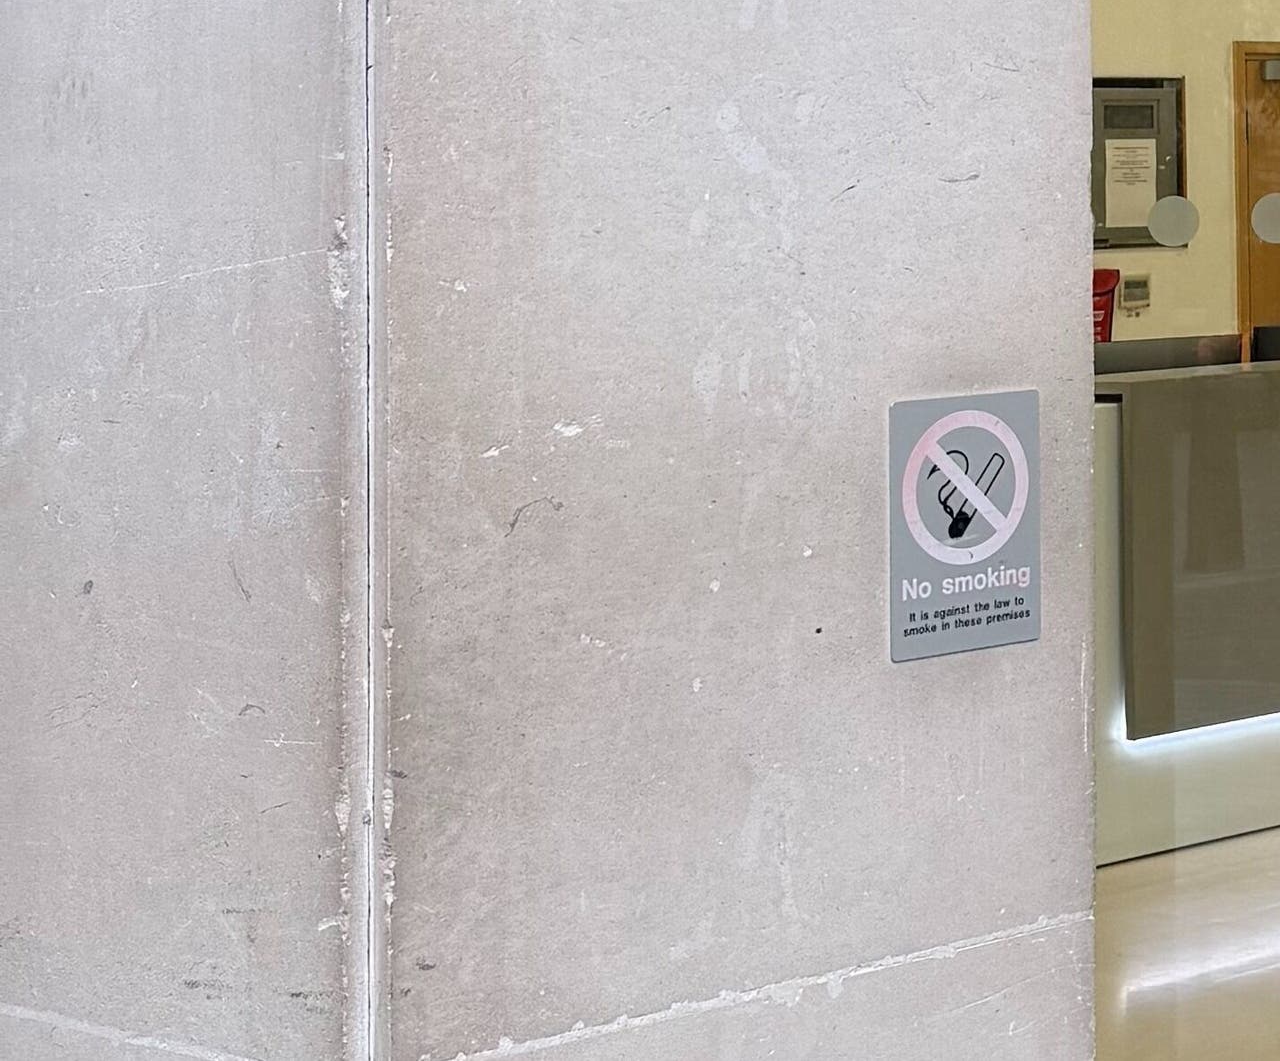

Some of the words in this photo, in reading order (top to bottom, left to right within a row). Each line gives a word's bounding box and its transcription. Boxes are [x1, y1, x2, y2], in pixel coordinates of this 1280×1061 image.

[902, 578, 932, 601] No
[942, 566, 1030, 595] smoking
[904, 623, 937, 637] smoke
[942, 621, 950, 630] in
[955, 617, 982, 629] these
[986, 609, 1030, 625] premises
[909, 613, 916, 622] It
[921, 610, 929, 620] is
[934, 604, 970, 620] against
[975, 602, 989, 611] the
[994, 599, 1010, 609] law
[1015, 597, 1024, 606] to
